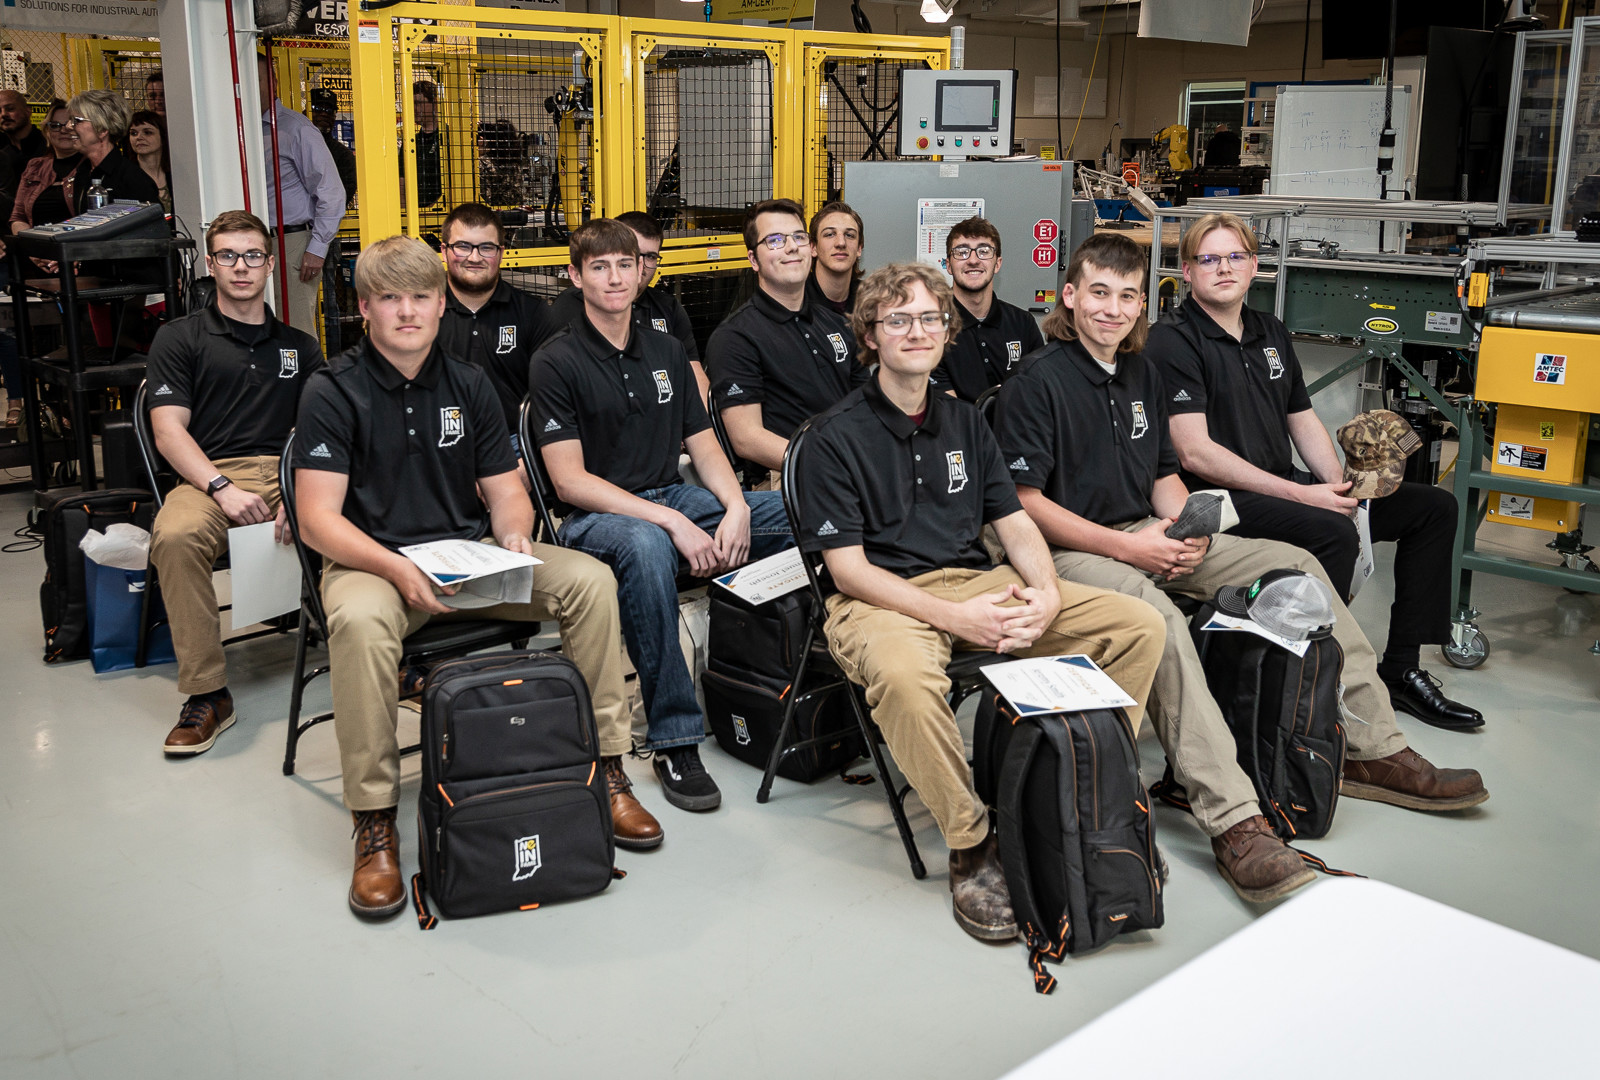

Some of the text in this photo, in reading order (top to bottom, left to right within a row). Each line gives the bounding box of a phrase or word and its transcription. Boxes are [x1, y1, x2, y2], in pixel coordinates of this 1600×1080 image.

[21, 0, 70, 12] SOLUTIONS
[72, 4, 88, 13] FOR
[90, 5, 140, 16] INDUSTRIAL
[1040, 226, 1052, 236] E1
[1038, 250, 1051, 260] H1
[502, 334, 513, 342] IN
[284, 358, 295, 366] IN
[658, 380, 669, 389] IN
[445, 419, 460, 430] IN
[952, 463, 962, 475] IN
[520, 849, 536, 861] IN
